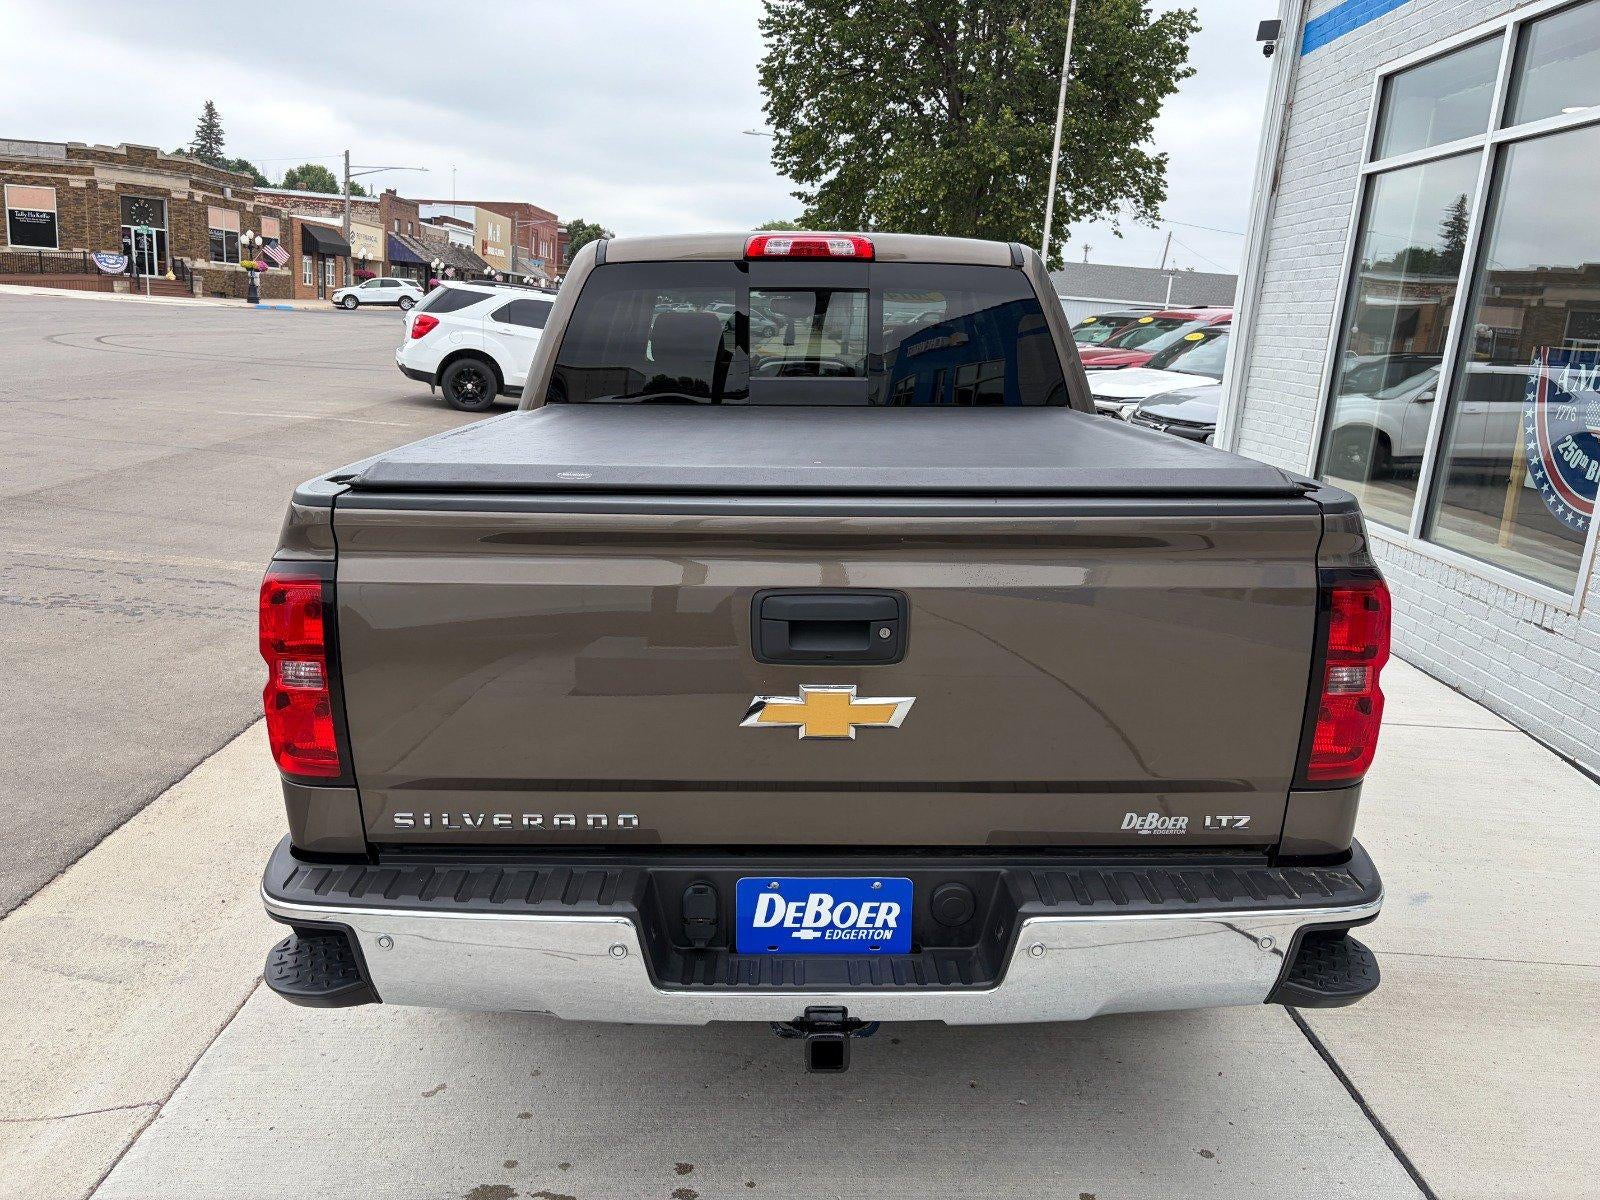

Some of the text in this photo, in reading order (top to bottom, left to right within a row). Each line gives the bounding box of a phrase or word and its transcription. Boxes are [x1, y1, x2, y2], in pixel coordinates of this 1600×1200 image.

[1555, 363, 1600, 395] AM
[1556, 405, 1576, 421] 1776
[393, 812, 639, 830] SILVERADO
[1203, 815, 1251, 829] LTZ
[825, 929, 894, 940] EDGERTON
